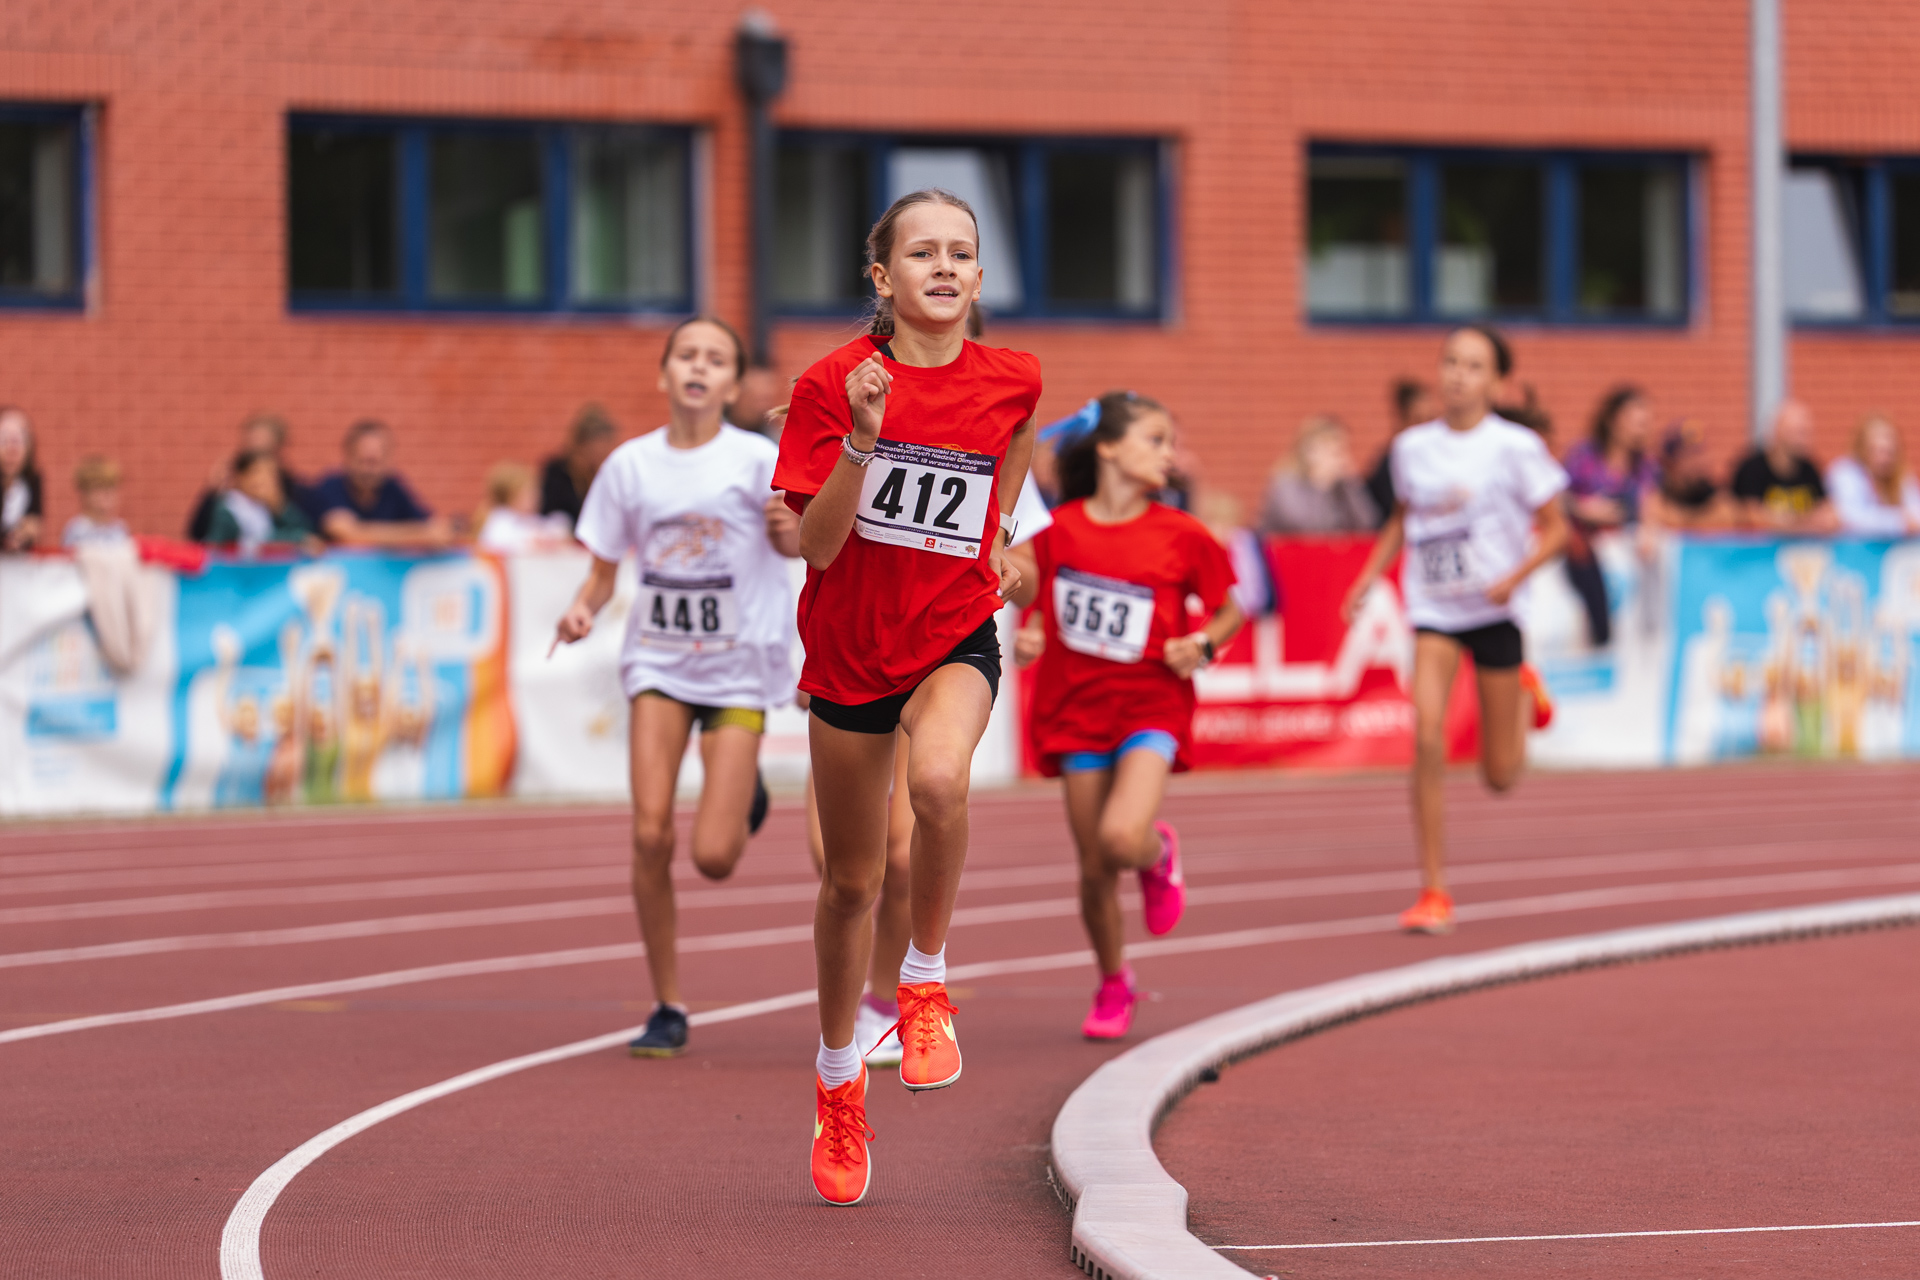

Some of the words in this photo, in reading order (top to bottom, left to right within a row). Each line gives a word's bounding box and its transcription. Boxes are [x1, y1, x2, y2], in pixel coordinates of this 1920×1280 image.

[905, 443, 949, 456] Ogólnopolski
[950, 450, 967, 458] Finał
[931, 452, 956, 462] Nadziei
[957, 457, 992, 467] Olimpijskich
[928, 459, 960, 470] września
[960, 464, 978, 472] 2025
[871, 467, 968, 531] 412
[651, 594, 720, 633] 448
[1063, 590, 1130, 638] 553
